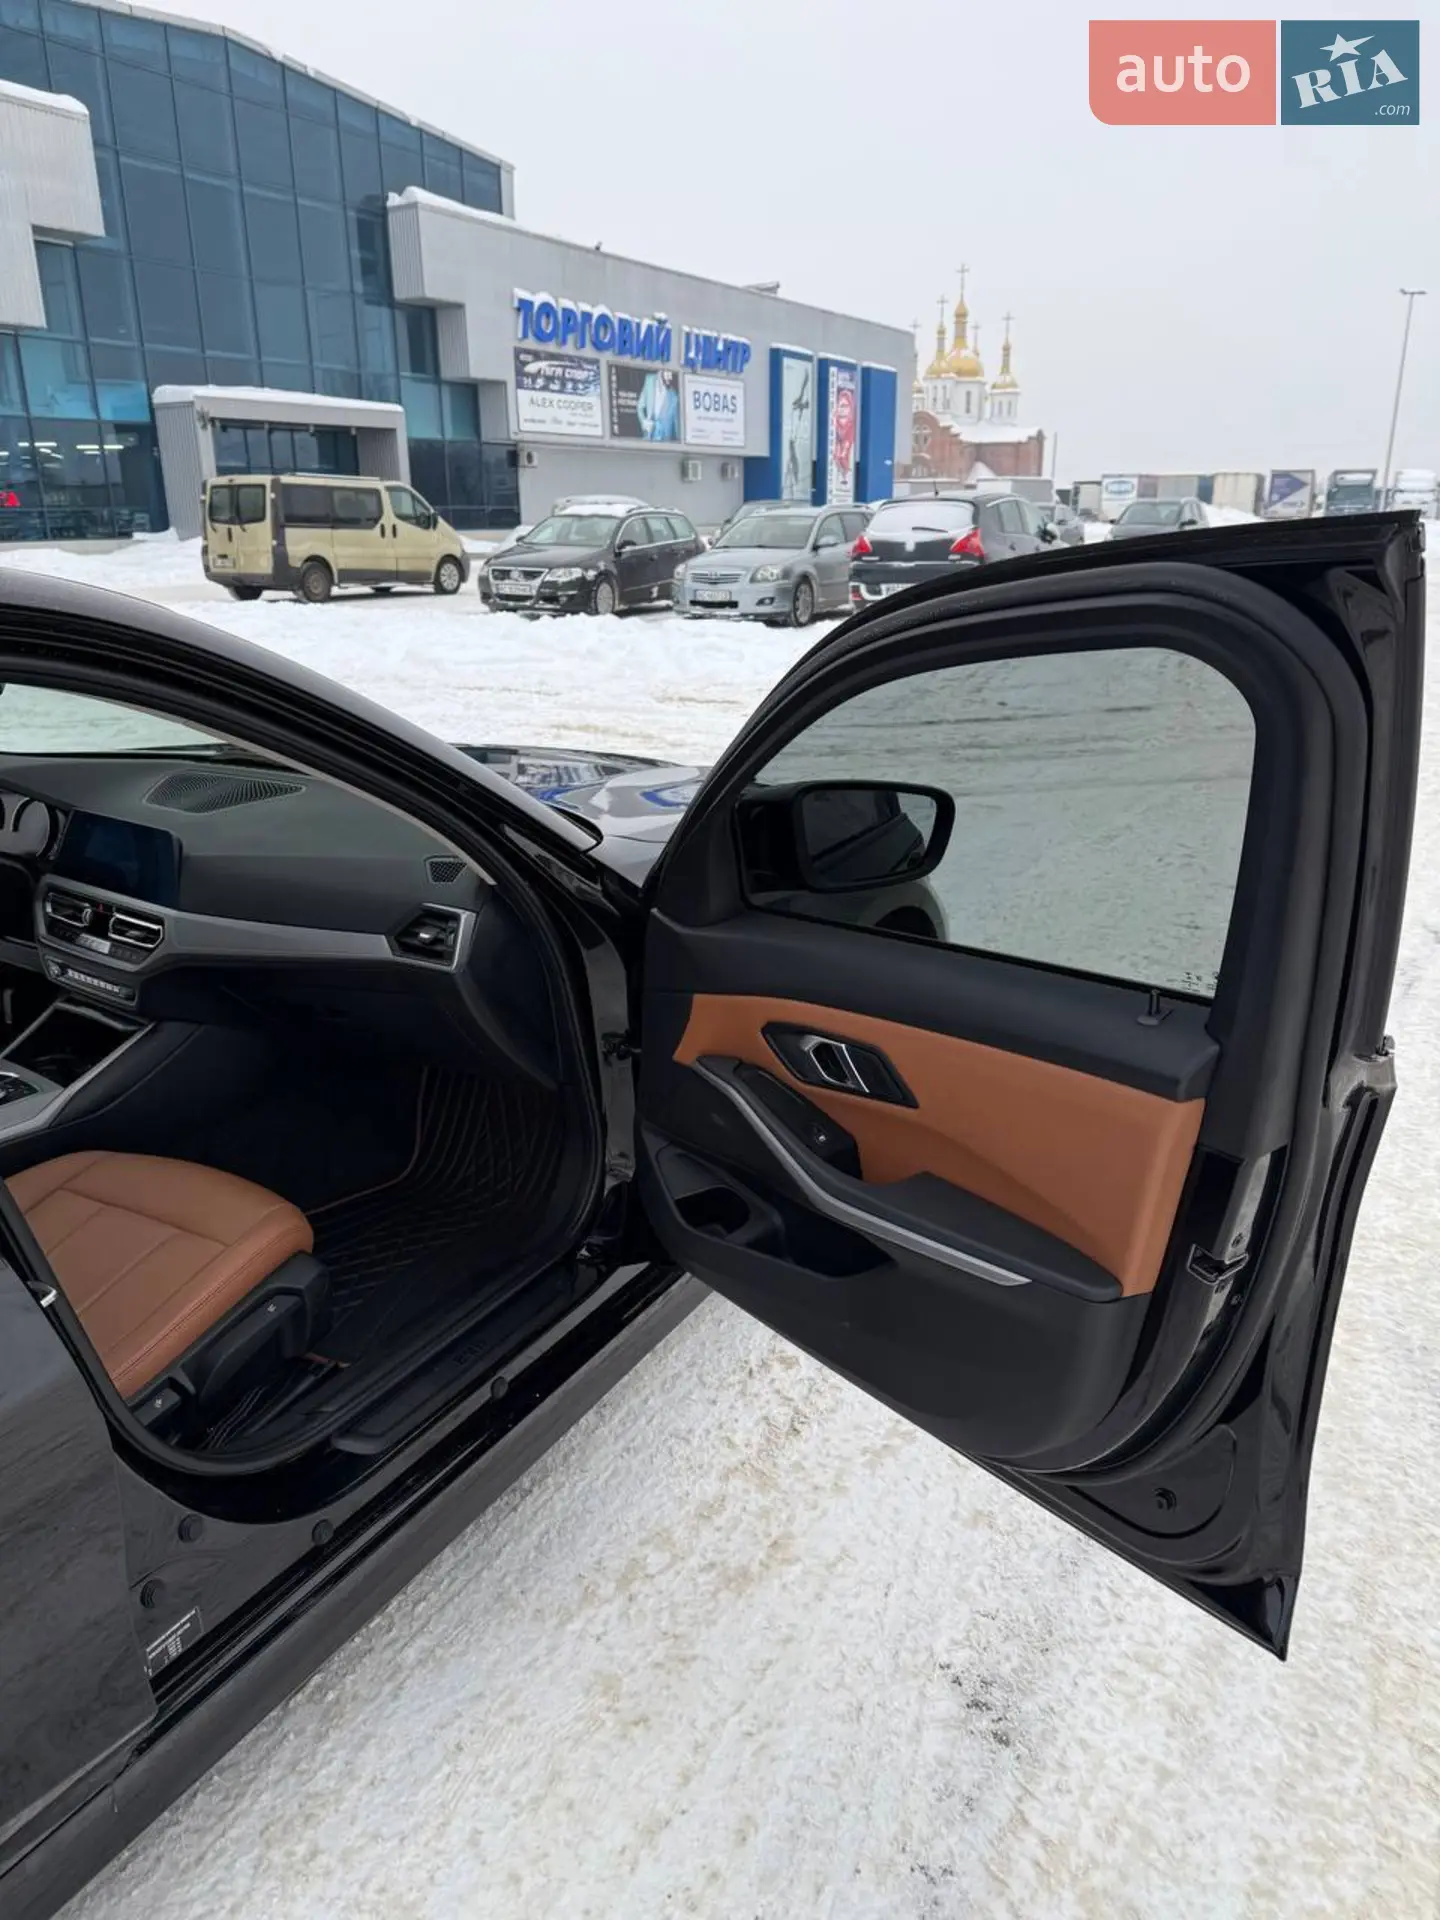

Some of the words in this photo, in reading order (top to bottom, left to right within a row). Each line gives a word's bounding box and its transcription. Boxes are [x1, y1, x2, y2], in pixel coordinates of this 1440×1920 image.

[514, 292, 673, 364] ТОРГОВИЙ
[528, 395, 555, 409] ALEX
[556, 398, 594, 412] COOPER
[692, 390, 737, 414] BOBAS
